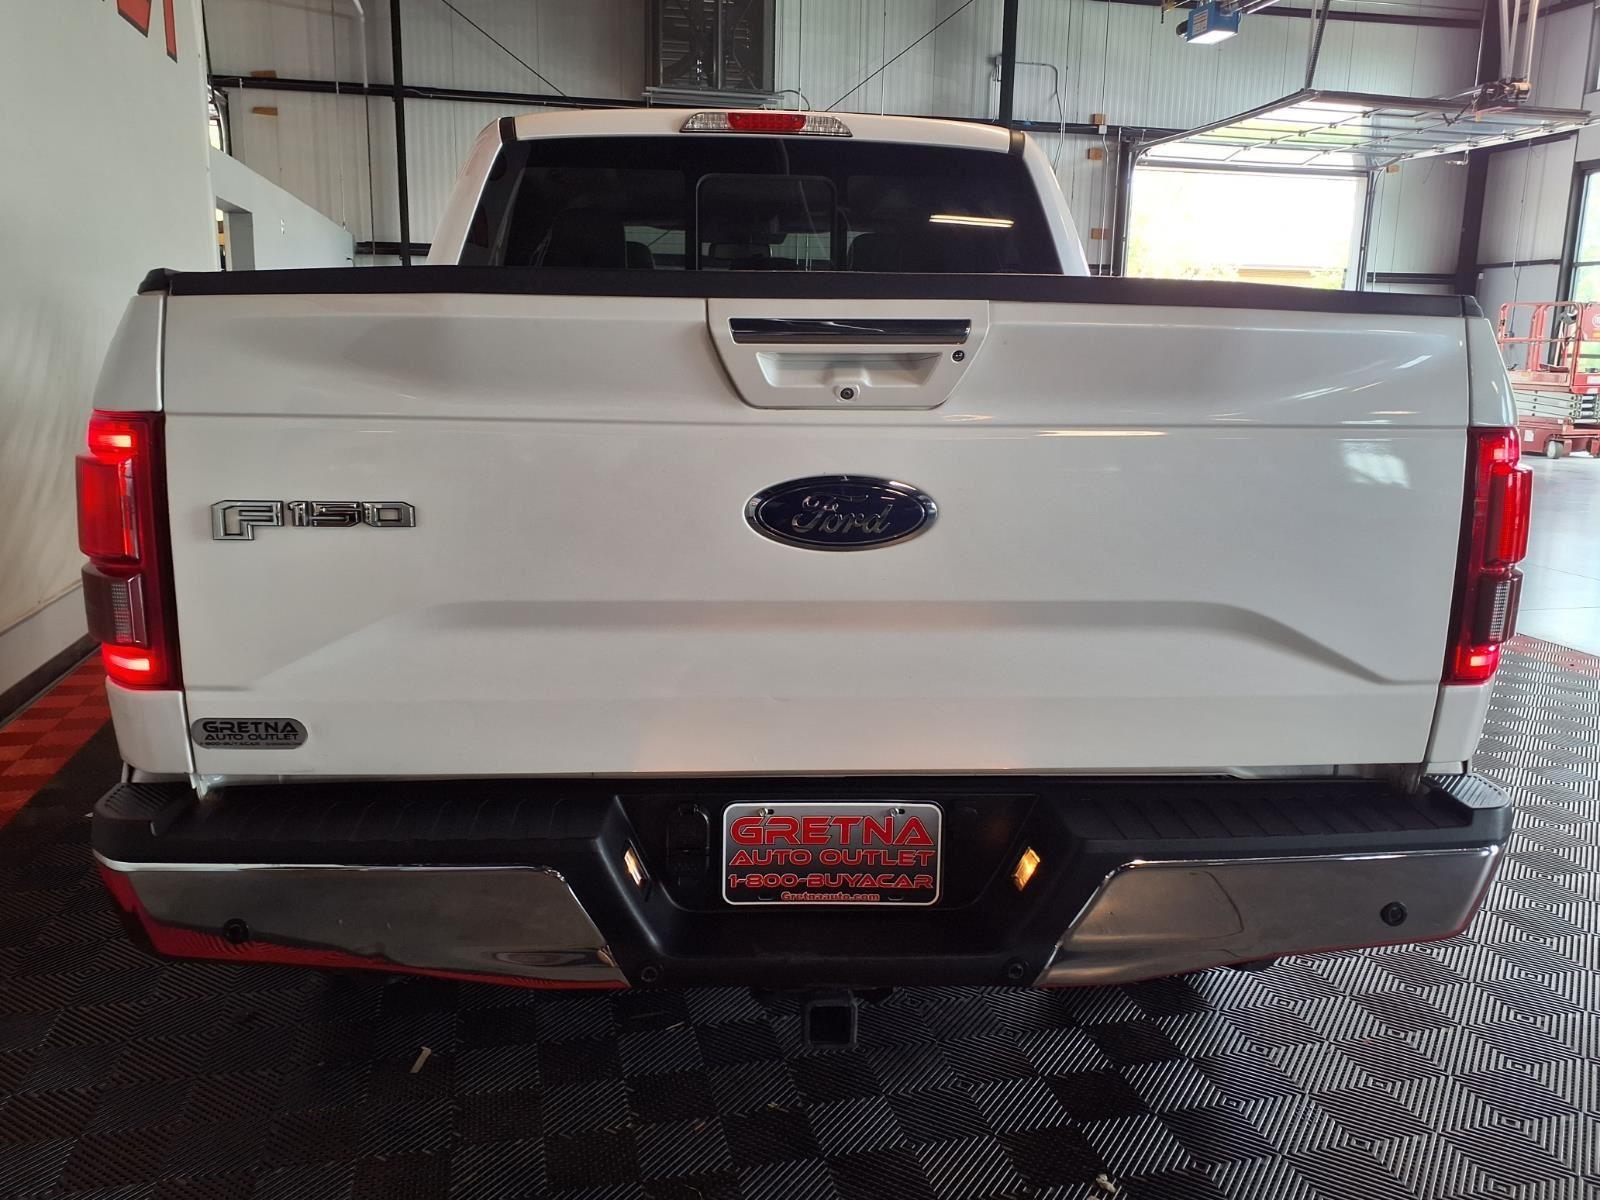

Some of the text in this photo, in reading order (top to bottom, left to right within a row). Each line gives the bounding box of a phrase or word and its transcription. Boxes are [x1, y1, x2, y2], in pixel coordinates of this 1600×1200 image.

[791, 493, 894, 534] Ford
[202, 720, 299, 733] GRETNA
[204, 733, 299, 741] AUTO OUTLET
[730, 815, 934, 846] GRETNA
[729, 849, 936, 867] AUTO OUTLET
[728, 873, 933, 889] 1-800-BUYACAR
[781, 891, 880, 901] Gretnaauto.com
